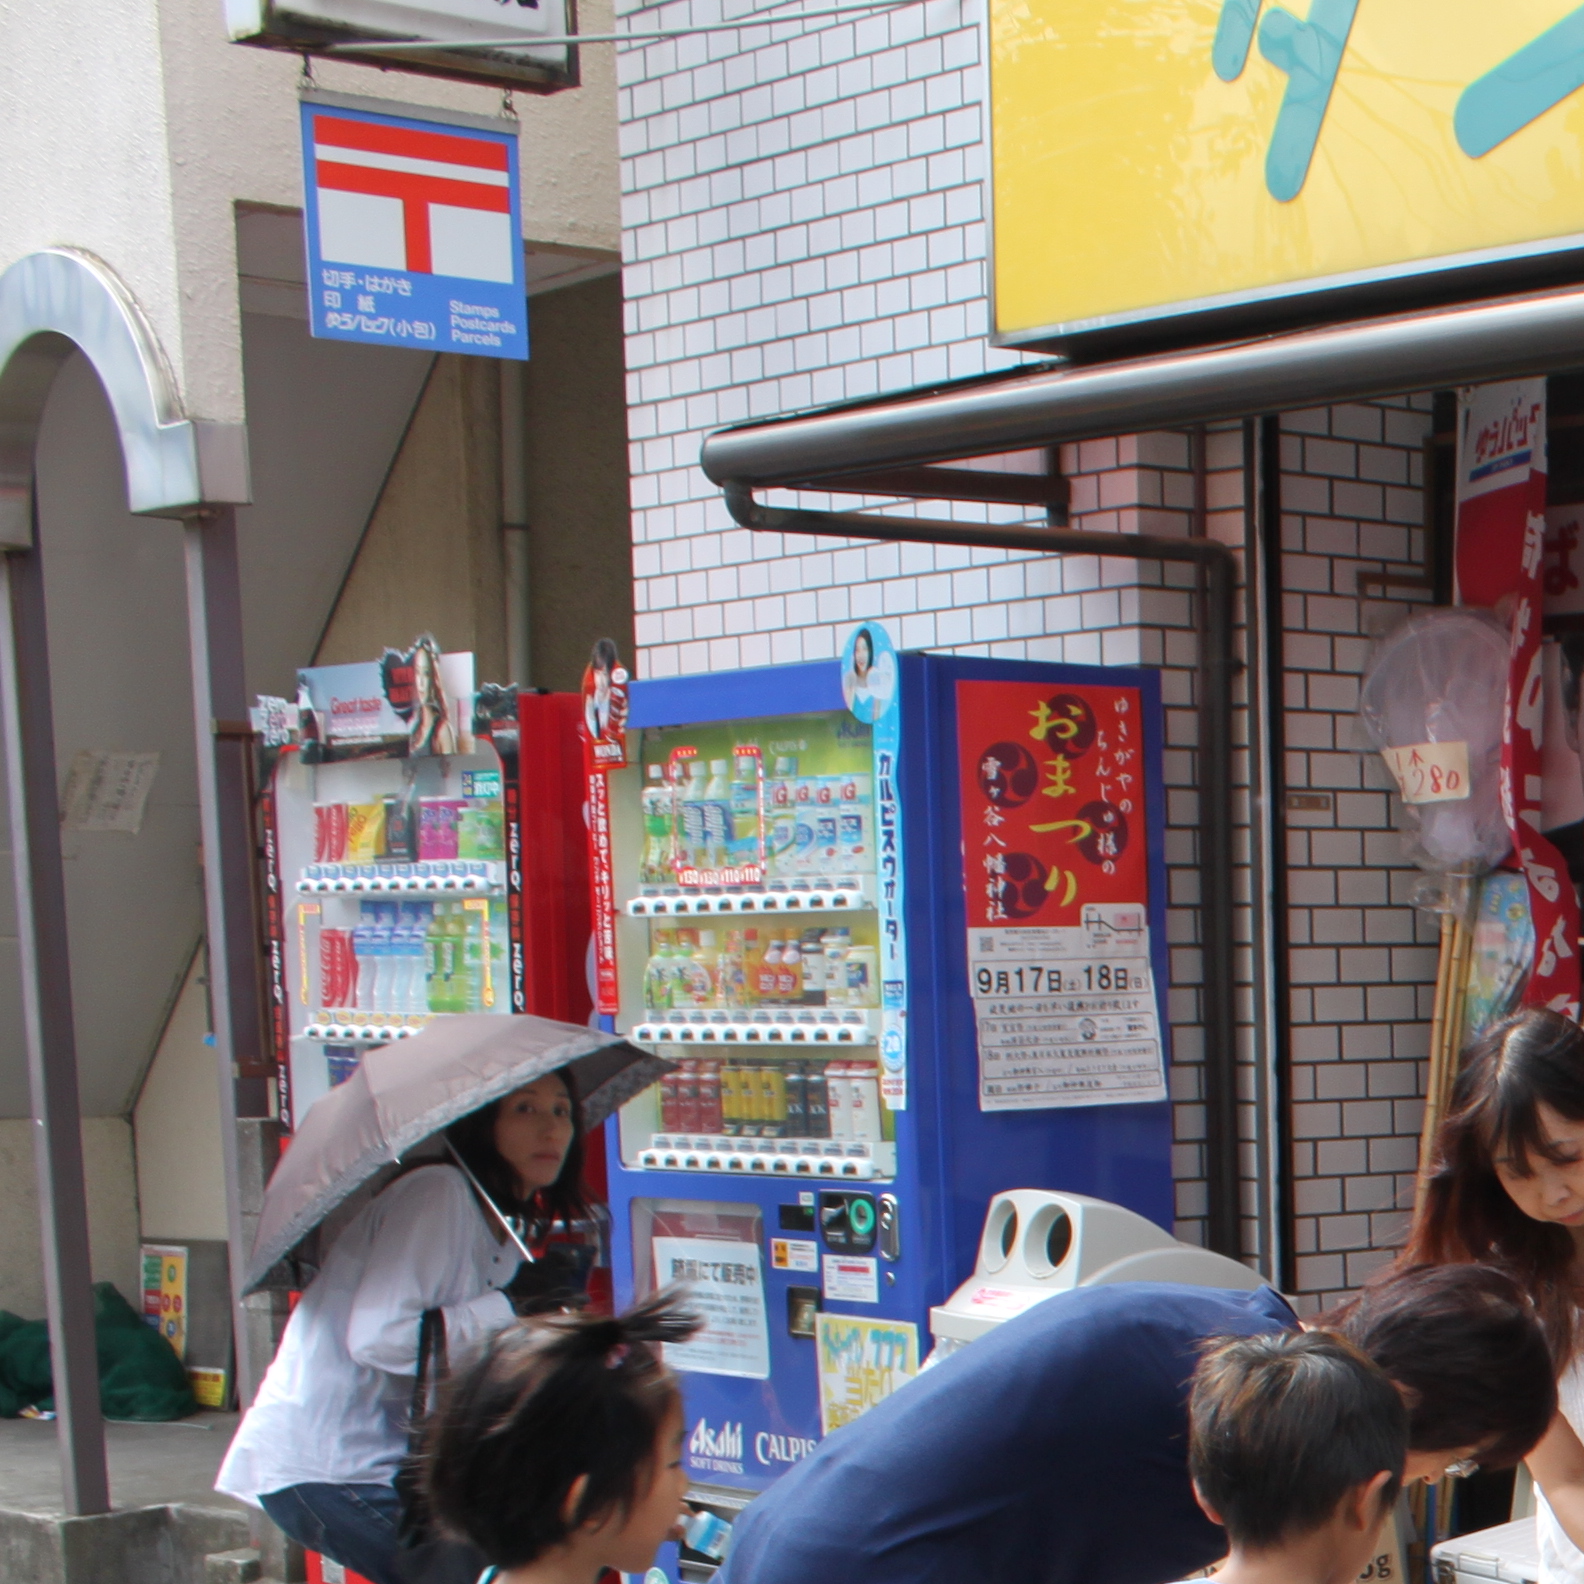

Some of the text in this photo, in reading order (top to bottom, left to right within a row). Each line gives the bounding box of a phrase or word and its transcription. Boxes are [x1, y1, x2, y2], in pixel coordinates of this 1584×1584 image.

[322, 268, 412, 296] 切手・はがき
[449, 300, 499, 318] Stamps
[451, 315, 517, 334] Postcards
[452, 329, 502, 347] Parcels
[1114, 697, 1135, 814] ゆきがやの
[1028, 700, 1093, 907] おまつり
[879, 753, 899, 960] カルピスウォーター
[690, 1416, 743, 1460] Asahi
[690, 1456, 744, 1474] SOFT DRINKS
